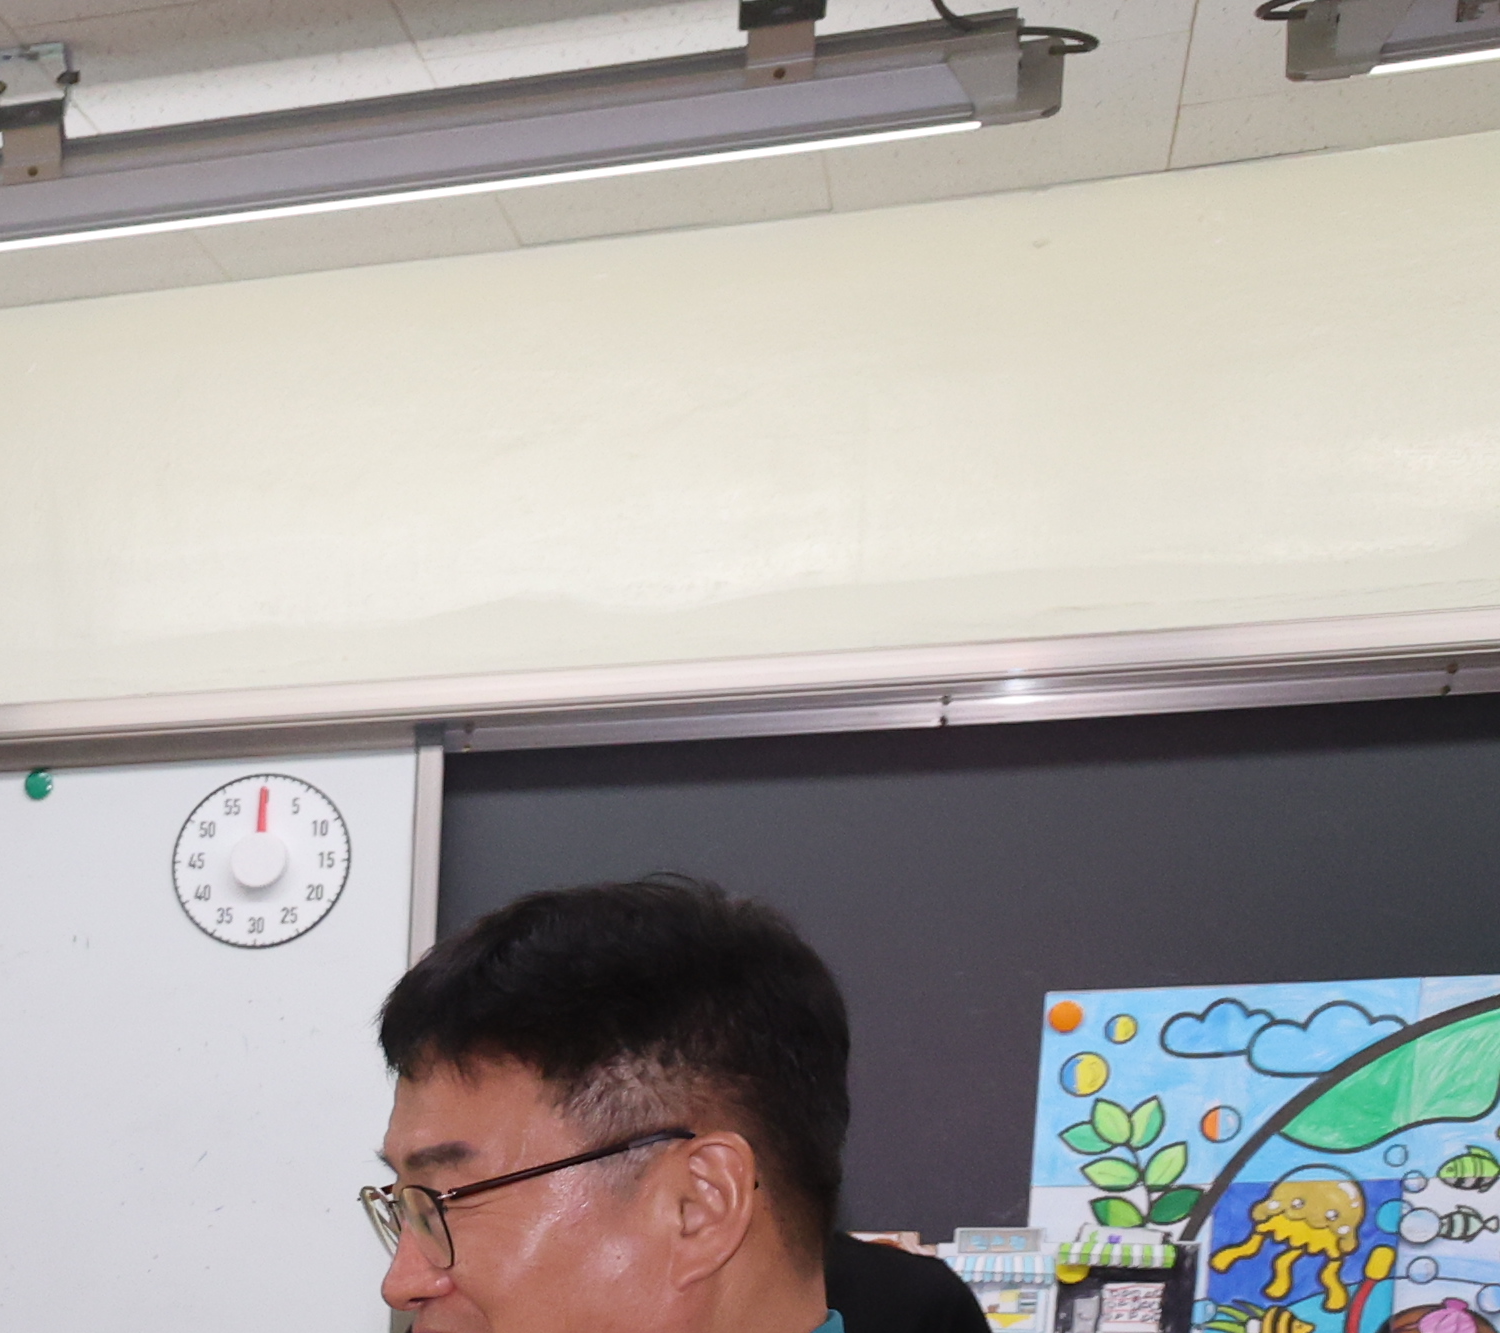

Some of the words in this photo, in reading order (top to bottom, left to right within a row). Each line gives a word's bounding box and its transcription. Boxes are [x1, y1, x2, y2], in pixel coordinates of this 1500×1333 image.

[224, 798, 241, 816] 55
[292, 797, 300, 815] 5
[199, 821, 216, 838] 50
[312, 819, 329, 837] 10
[188, 852, 205, 870] 45
[318, 851, 335, 869] 15
[194, 884, 211, 902] 40
[306, 884, 324, 901] 20
[216, 907, 234, 925] 35
[280, 907, 298, 925] 25
[248, 917, 265, 934] 30
